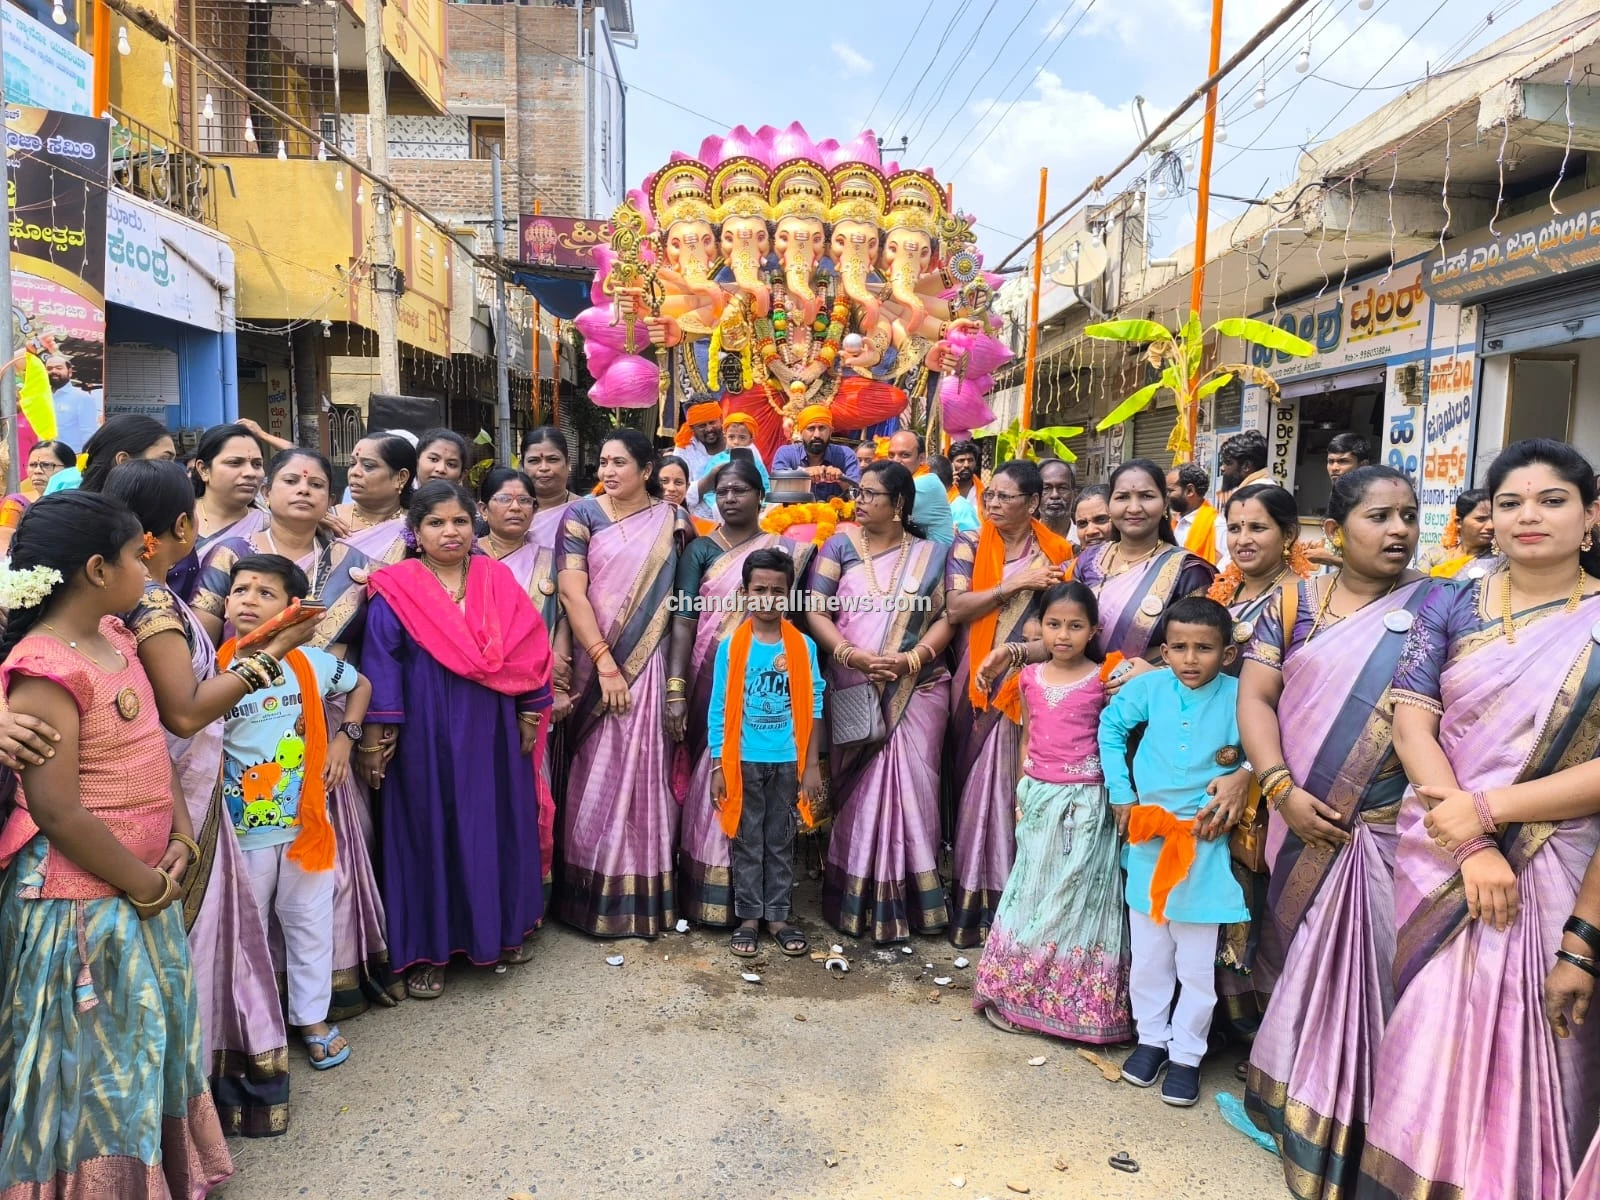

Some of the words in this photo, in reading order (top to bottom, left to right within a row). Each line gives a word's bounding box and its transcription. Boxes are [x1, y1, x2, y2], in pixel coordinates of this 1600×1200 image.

[48, 137, 94, 158] ಸಮಿತಿ
[9, 219, 85, 251] ಹೋತ್ಸವ
[108, 227, 175, 287] ಕೇಂದ್ರ.
[1350, 274, 1425, 335] ಟೈಲರ್
